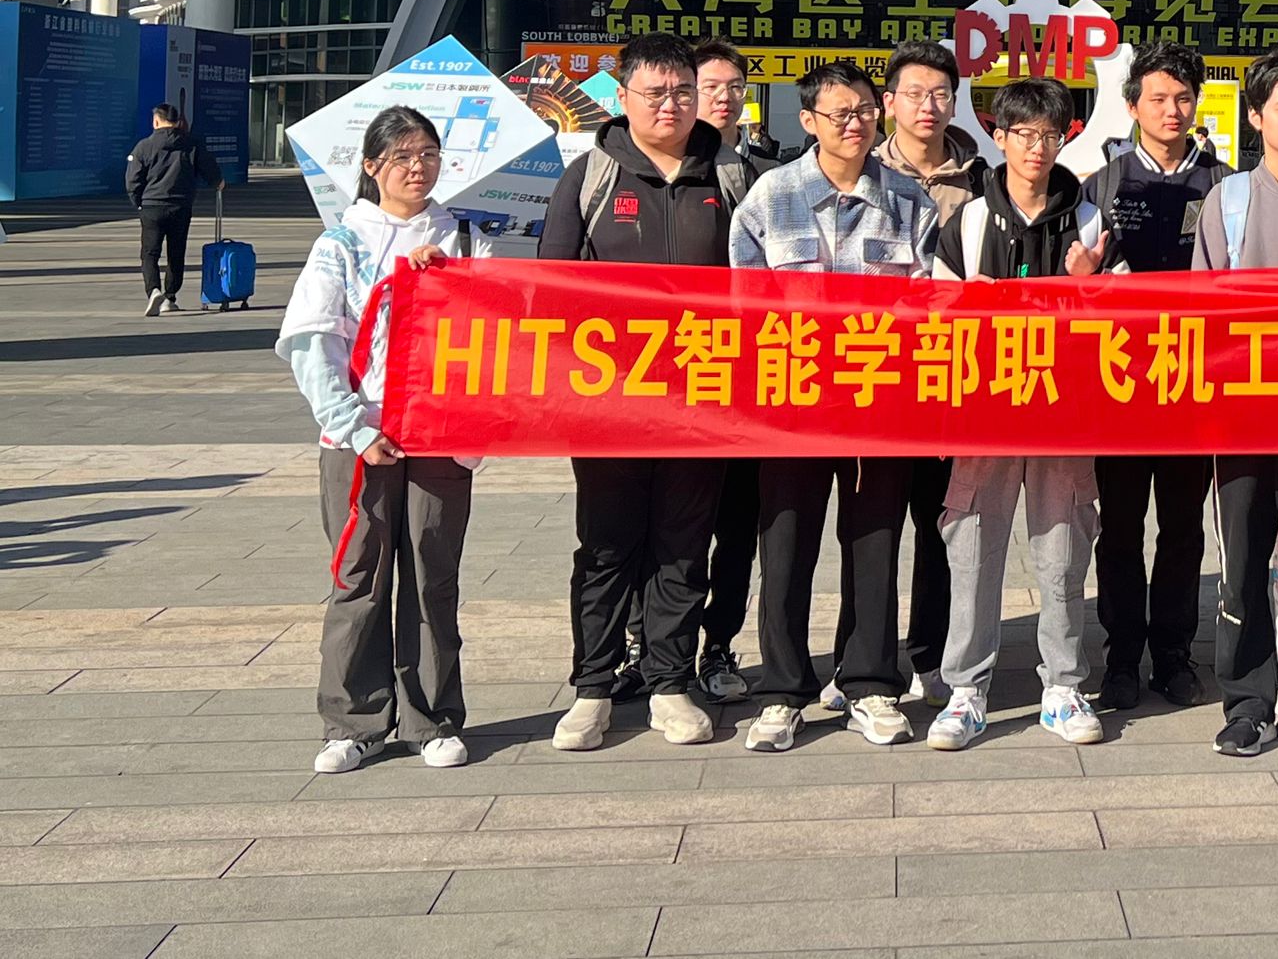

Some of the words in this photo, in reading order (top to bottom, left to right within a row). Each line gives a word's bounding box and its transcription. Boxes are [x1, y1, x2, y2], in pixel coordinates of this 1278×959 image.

[607, 14, 773, 39] GREATER
[793, 18, 862, 39] BAY
[881, 20, 956, 41] ARE
[522, 31, 562, 41] SOUTH
[567, 32, 620, 42] LOBBY(E)
[955, 9, 1119, 80] DMP
[410, 59, 473, 72] Est.1907
[383, 82, 425, 91] JSW
[510, 159, 560, 173] Est.1907
[479, 189, 513, 200] JSW
